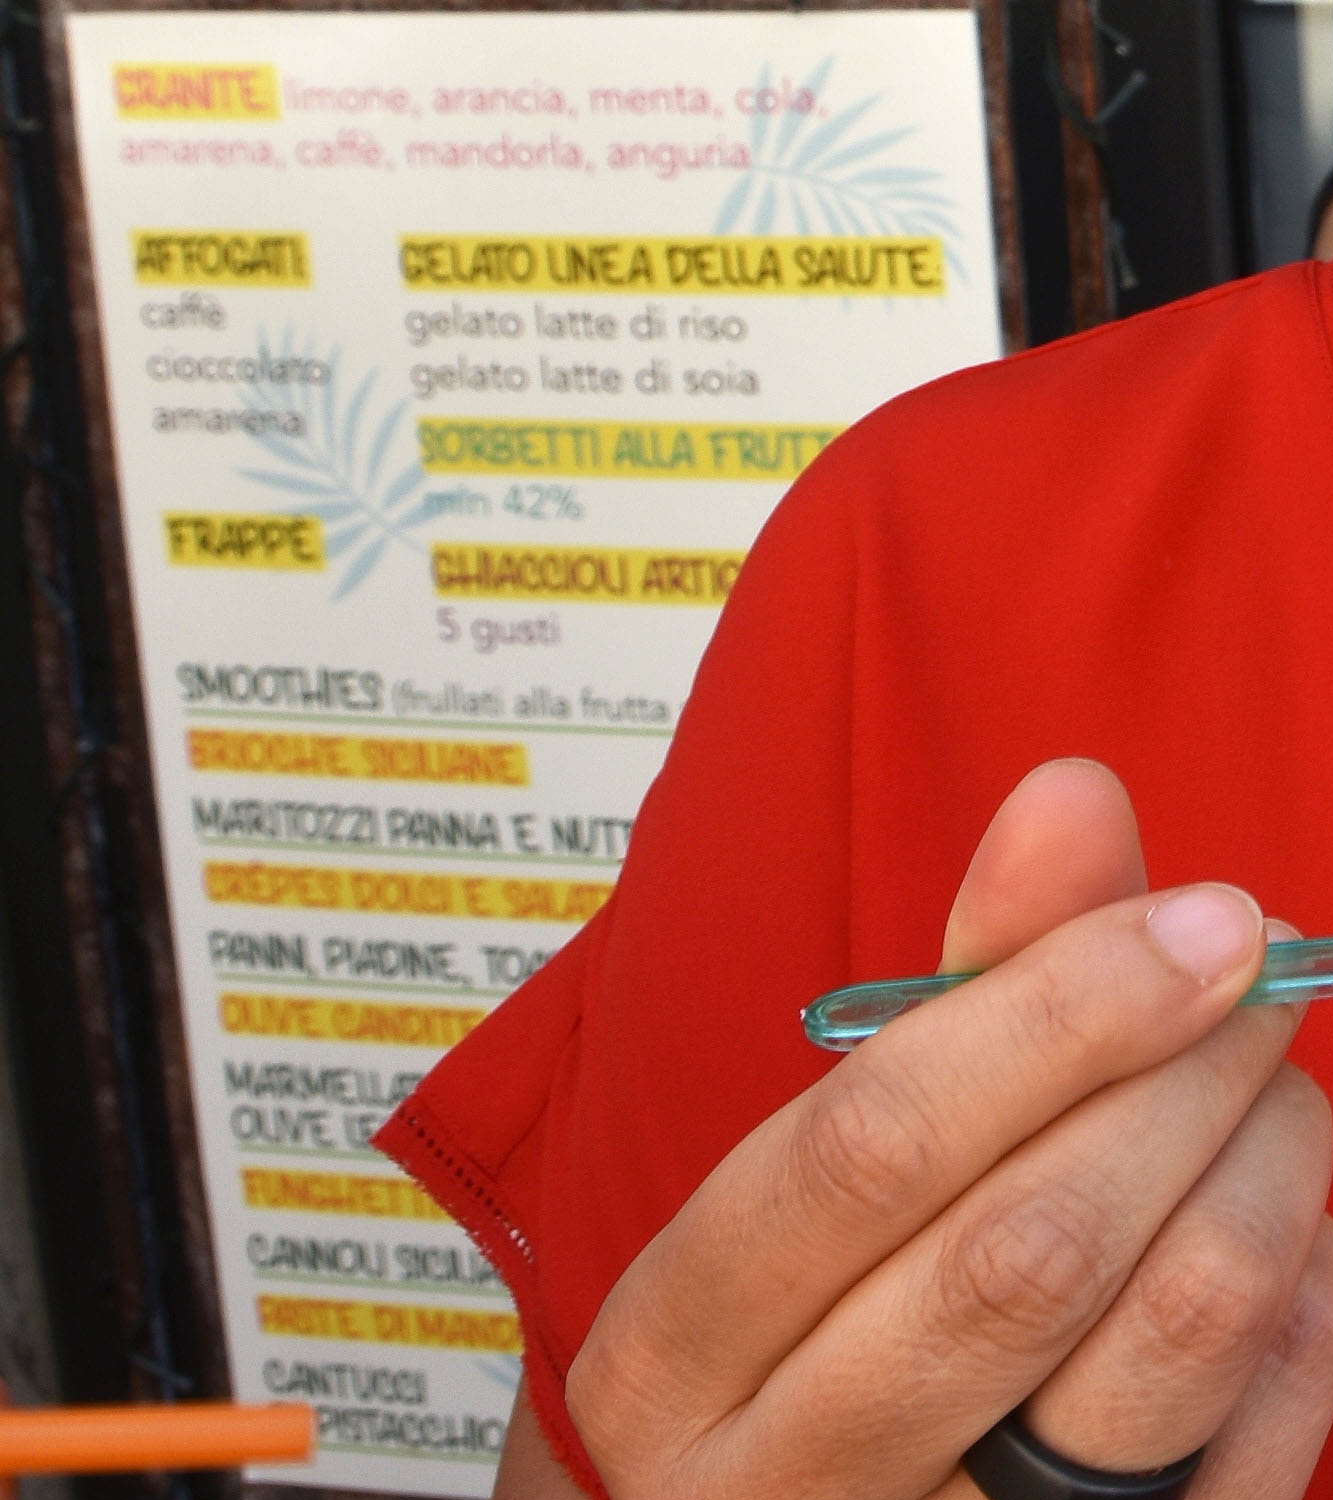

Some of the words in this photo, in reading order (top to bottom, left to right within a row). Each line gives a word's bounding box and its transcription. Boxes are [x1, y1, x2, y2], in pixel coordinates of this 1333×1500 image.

[432, 79, 580, 120] arancia,
[589, 80, 722, 120] menta,
[121, 139, 287, 171] amarena,
[405, 130, 597, 172] mandorla,
[607, 139, 752, 180] anguria
[400, 242, 533, 284] GELATO
[546, 243, 655, 285] LINEA
[665, 244, 784, 286] DELLA
[405, 302, 524, 347] gelato
[534, 302, 620, 339] latte
[630, 304, 667, 340] di
[679, 309, 748, 341] riso
[146, 344, 332, 386] cioccolato
[410, 356, 529, 400] gelato
[540, 356, 623, 395] latte
[635, 358, 671, 395] di
[683, 362, 762, 396] soia
[152, 403, 304, 438] amarena
[418, 426, 599, 467] SORBETTI
[613, 427, 694, 468] ALLA
[502, 484, 585, 520] 42%
[436, 607, 462, 644] 5
[471, 611, 563, 654] gusti
[176, 662, 384, 711] SMOOTHIES
[513, 687, 569, 720] alla
[580, 687, 671, 723] frutta
[194, 796, 379, 843] MARITOZZI
[388, 808, 498, 850] PANNA
[511, 813, 540, 853] E
[230, 1104, 333, 1149] OLIVE
[247, 1232, 385, 1278] CANNOLI
[263, 1358, 426, 1404] CANTUCCI
